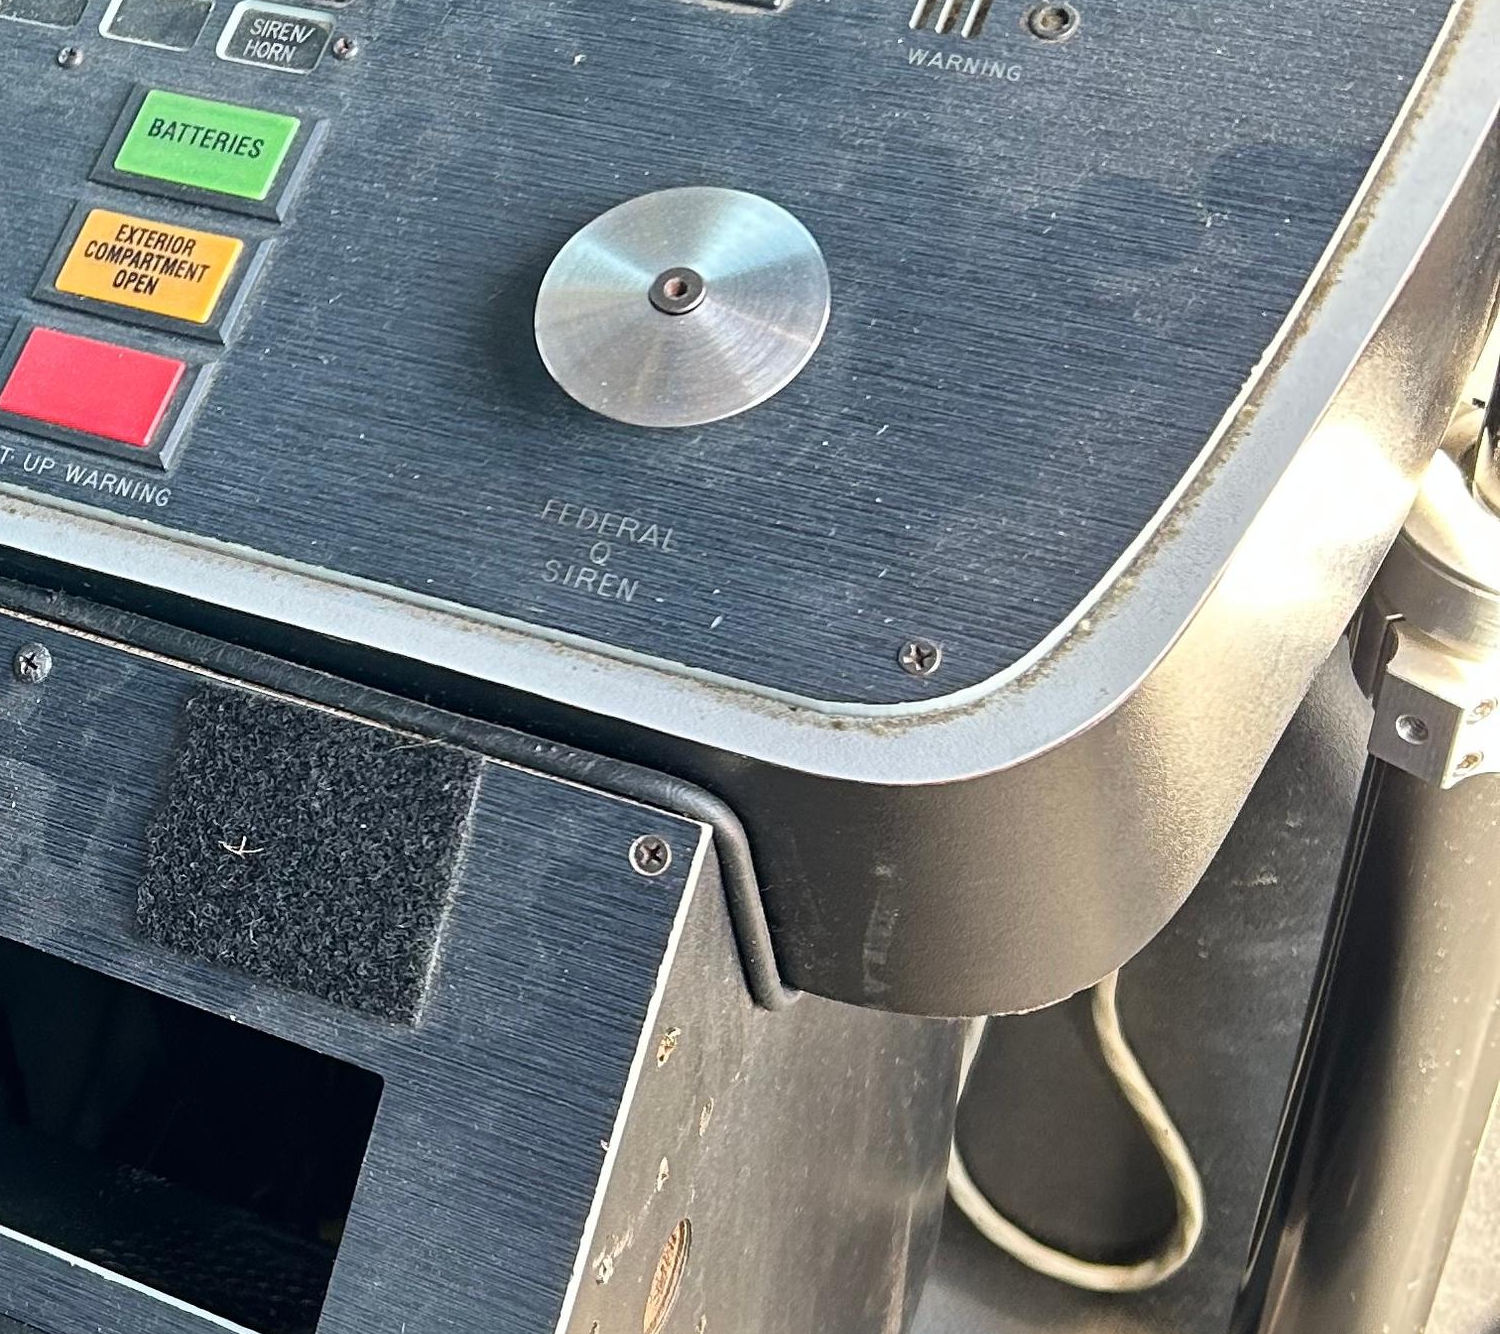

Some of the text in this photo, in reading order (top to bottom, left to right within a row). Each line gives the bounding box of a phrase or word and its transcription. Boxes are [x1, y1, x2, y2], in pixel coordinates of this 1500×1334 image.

[249, 17, 316, 44] SIREN/
[241, 38, 297, 62] HORN
[908, 48, 1022, 81] WARNING
[147, 118, 265, 159] BATTERIES
[115, 223, 197, 257] EXTERIOR
[83, 240, 211, 283] COMPARTMENT
[112, 269, 160, 296] OPEN
[23, 452, 56, 473] UP
[65, 465, 172, 508] WARNING
[540, 499, 680, 553] FEDERAL
[589, 541, 612, 566] Q
[541, 560, 640, 602] SIREN
